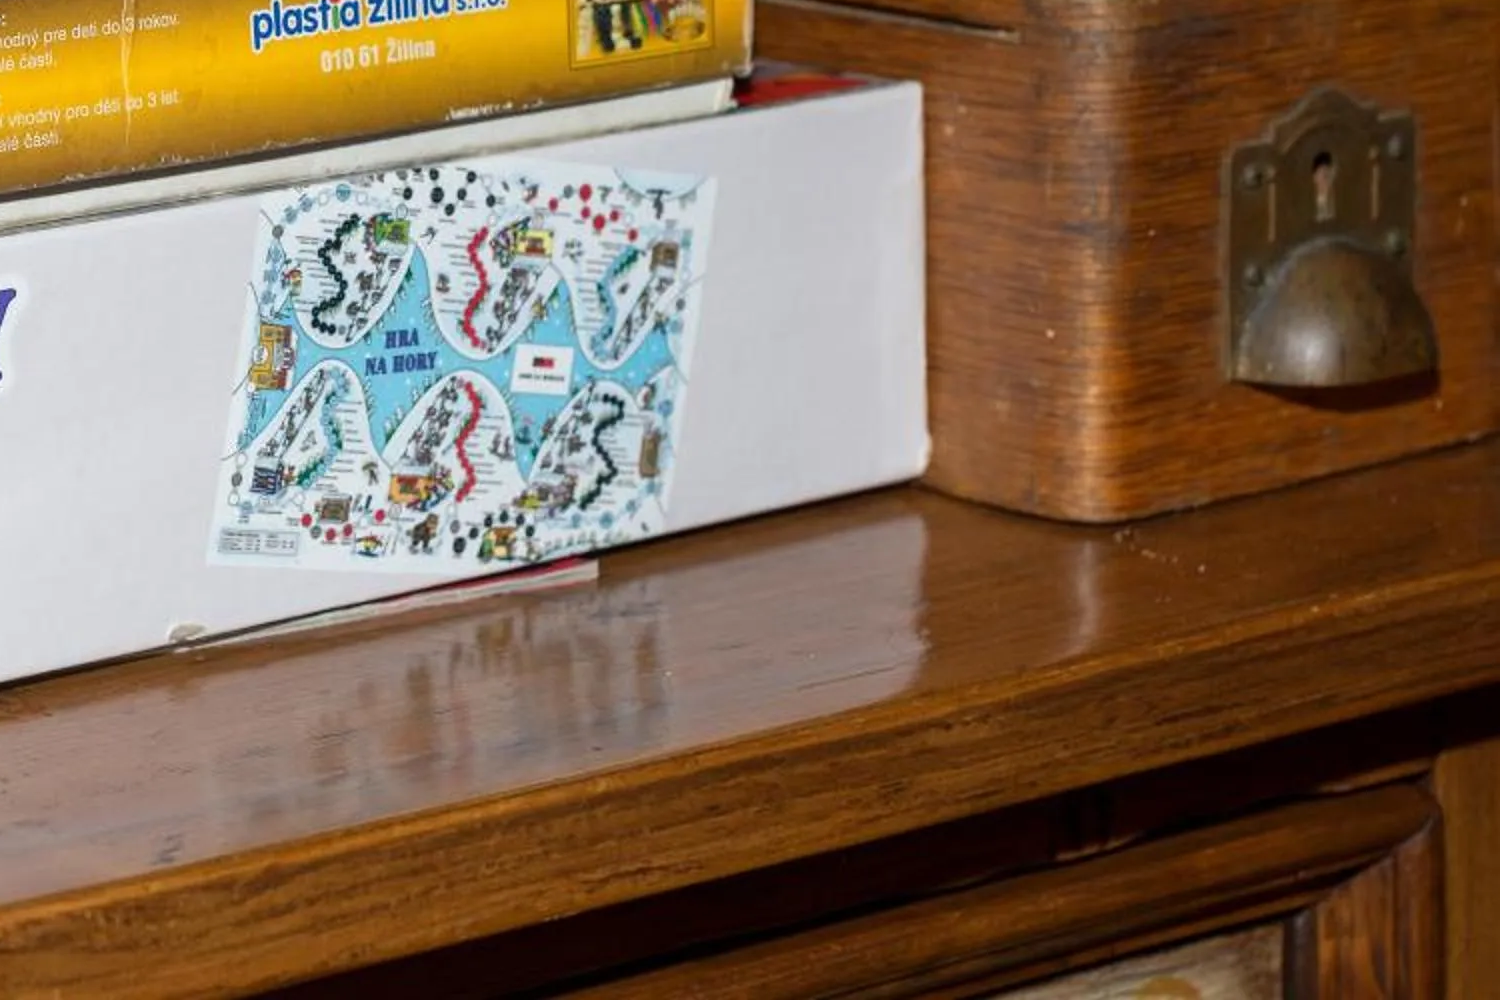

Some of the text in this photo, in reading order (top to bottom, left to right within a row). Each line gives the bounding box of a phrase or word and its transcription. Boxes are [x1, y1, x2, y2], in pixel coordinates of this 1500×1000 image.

[43, 30, 67, 45] pre
[101, 19, 120, 35] do
[124, 17, 135, 33] 3
[320, 37, 436, 73] 010 61 Žilina
[65, 105, 89, 121] pro
[147, 92, 157, 108] 3
[384, 327, 420, 350] HRA
[365, 351, 438, 377] NA HORY
